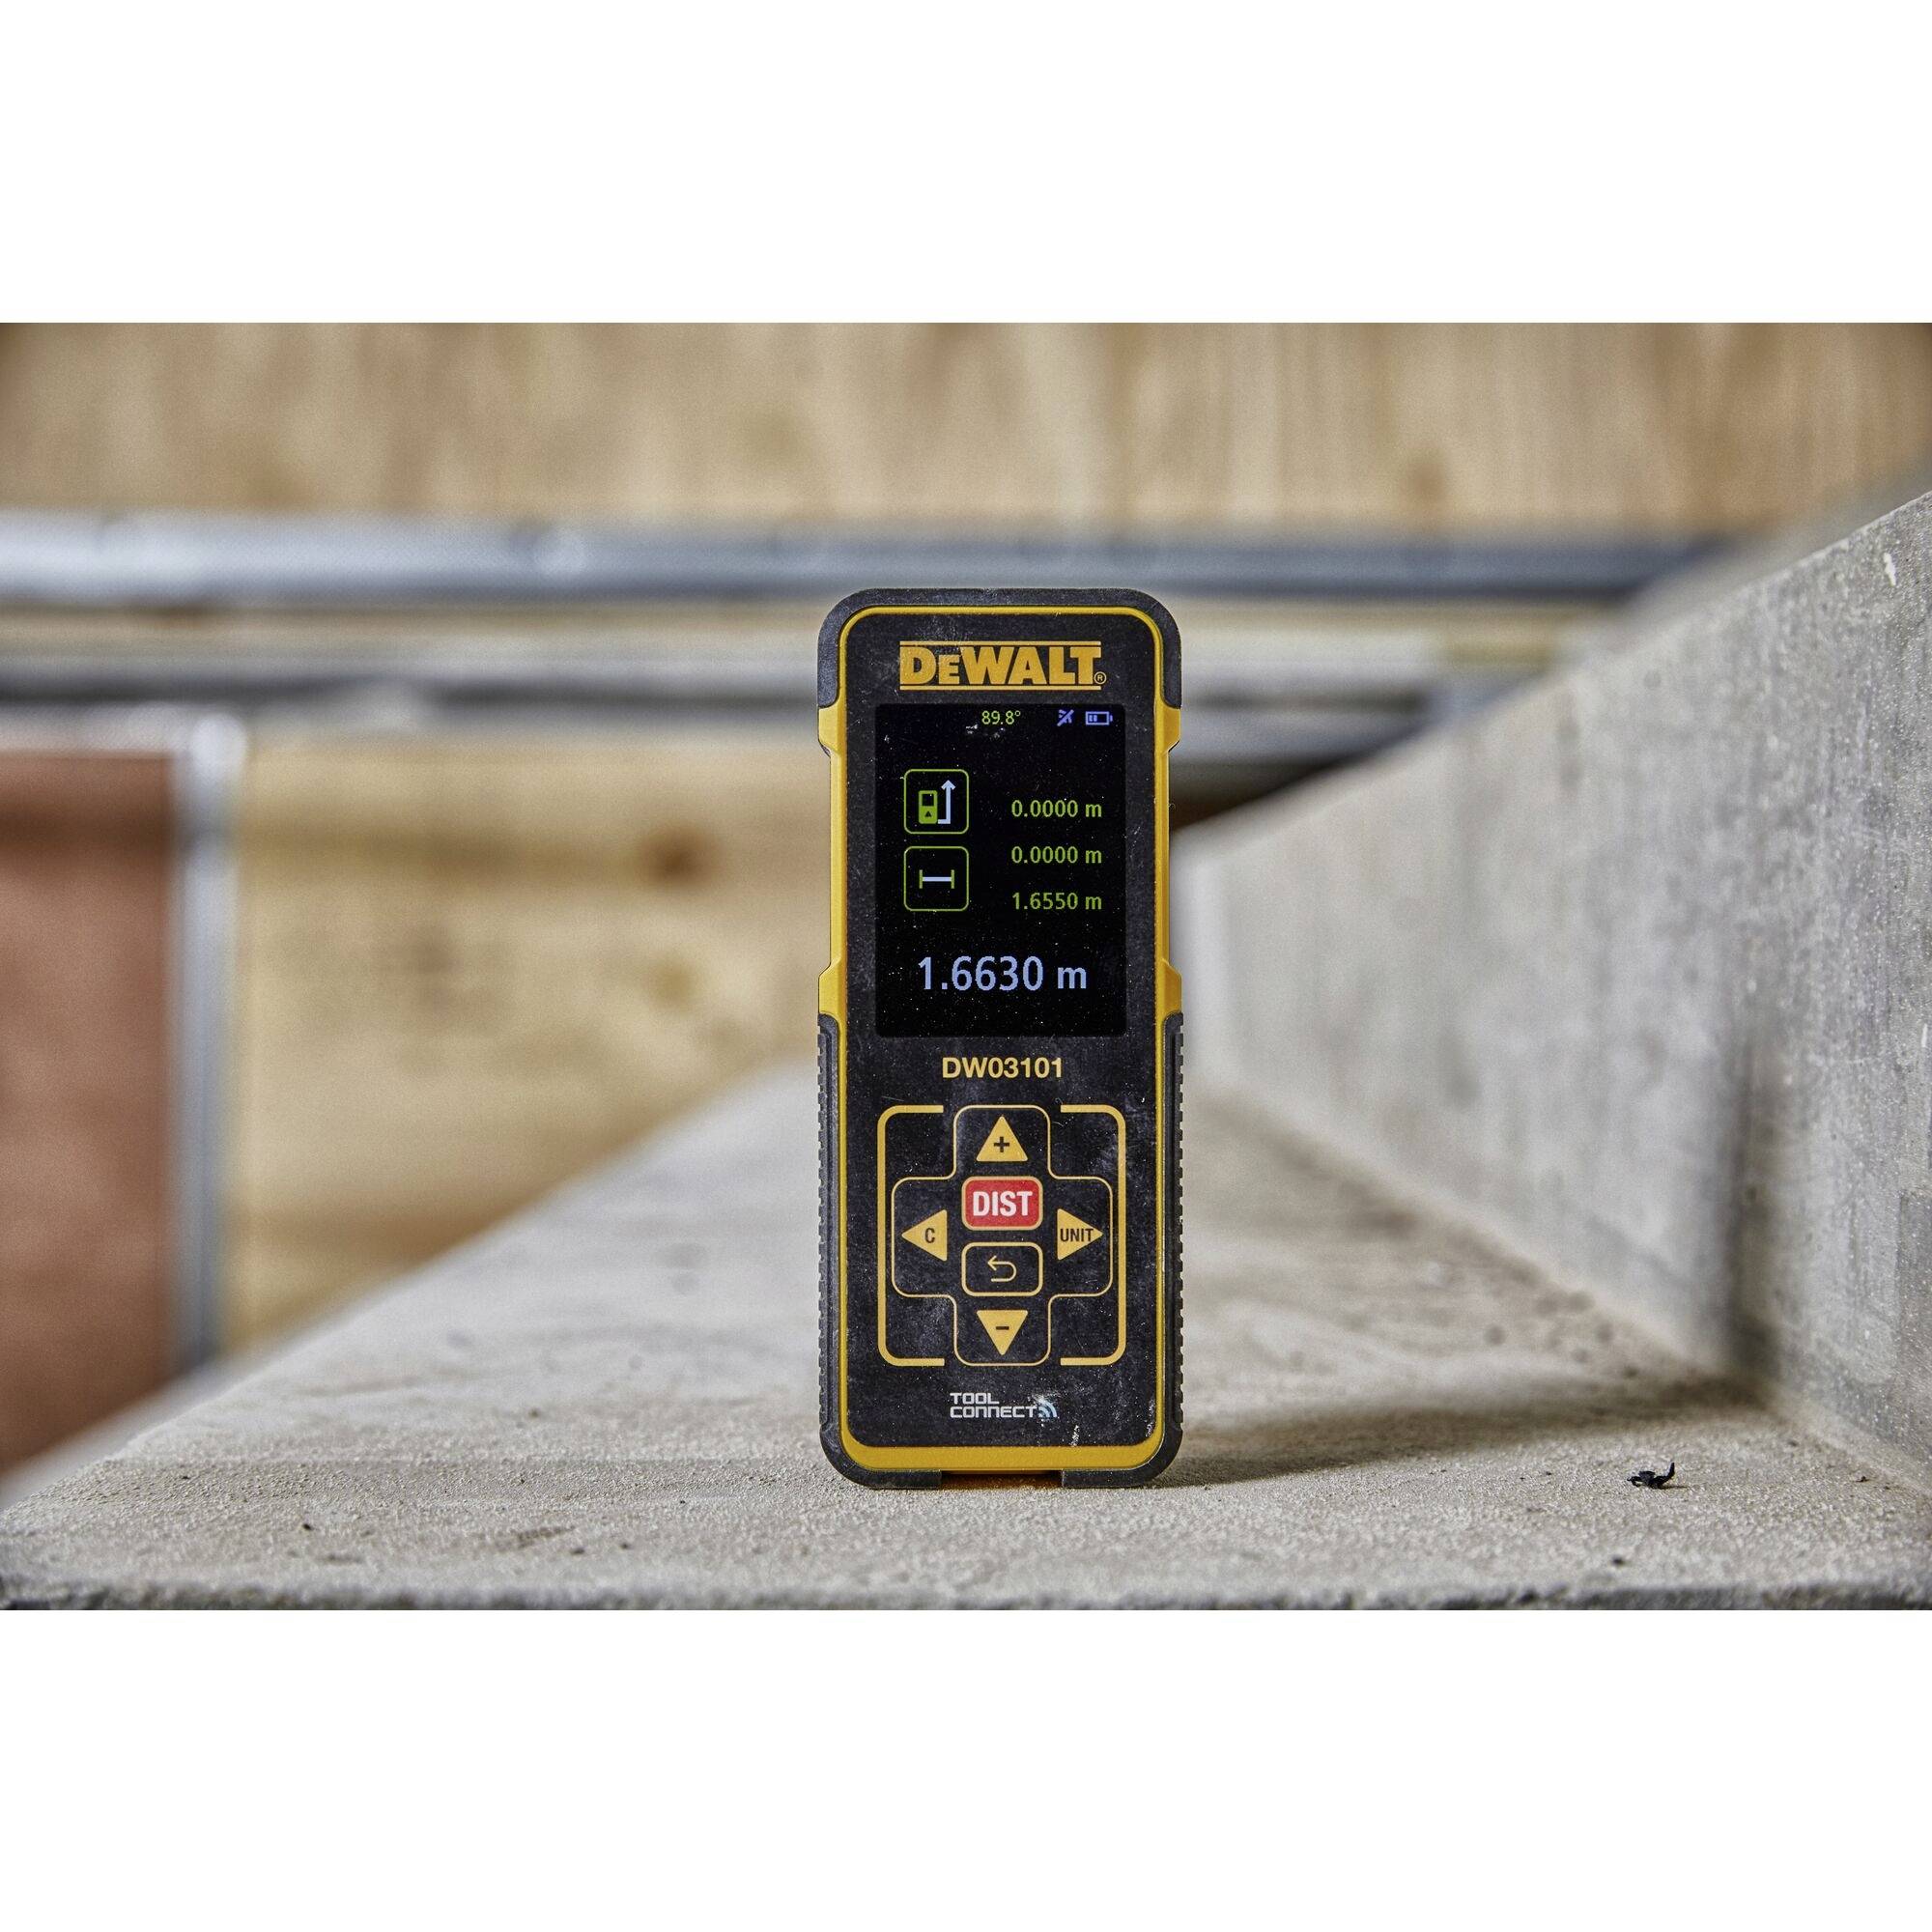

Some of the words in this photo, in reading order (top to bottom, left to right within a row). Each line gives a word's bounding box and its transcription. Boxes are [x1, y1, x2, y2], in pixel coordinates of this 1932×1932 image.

[1011, 800, 1078, 817] 0.0000
[1085, 804, 1102, 817] m
[1011, 846, 1078, 864] 0.0000
[1085, 850, 1102, 864] m
[1011, 893, 1078, 910] 1.6550
[1085, 896, 1102, 910] m
[918, 955, 1043, 991] 1.6630
[1057, 966, 1087, 989] m
[942, 1056, 1063, 1079] DW03101
[972, 1191, 1033, 1217] DIST
[924, 1228, 935, 1243] C
[1060, 1228, 1094, 1243] UNIT
[950, 1392, 999, 1405] TOOL
[950, 1406, 1037, 1418] CONNECT
